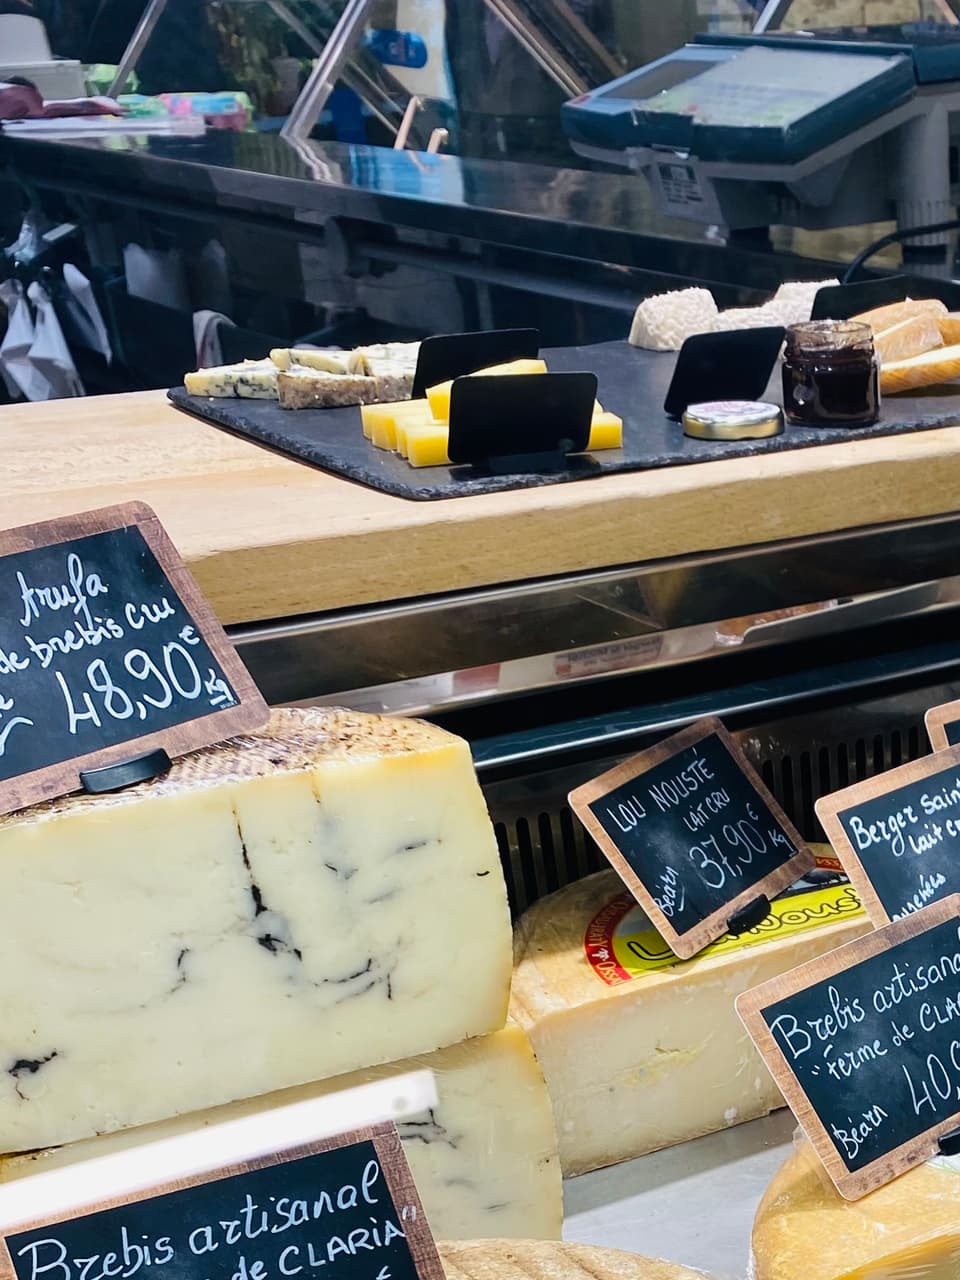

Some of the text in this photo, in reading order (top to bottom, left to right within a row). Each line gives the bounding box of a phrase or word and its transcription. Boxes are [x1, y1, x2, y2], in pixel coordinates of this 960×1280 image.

[25, 617, 124, 668] brebis
[849, 806, 918, 857] Berger
[908, 827, 943, 855] lait
[769, 986, 866, 1059] Brebis
[892, 1020, 915, 1046] de
[189, 1159, 380, 1256] artisanal
